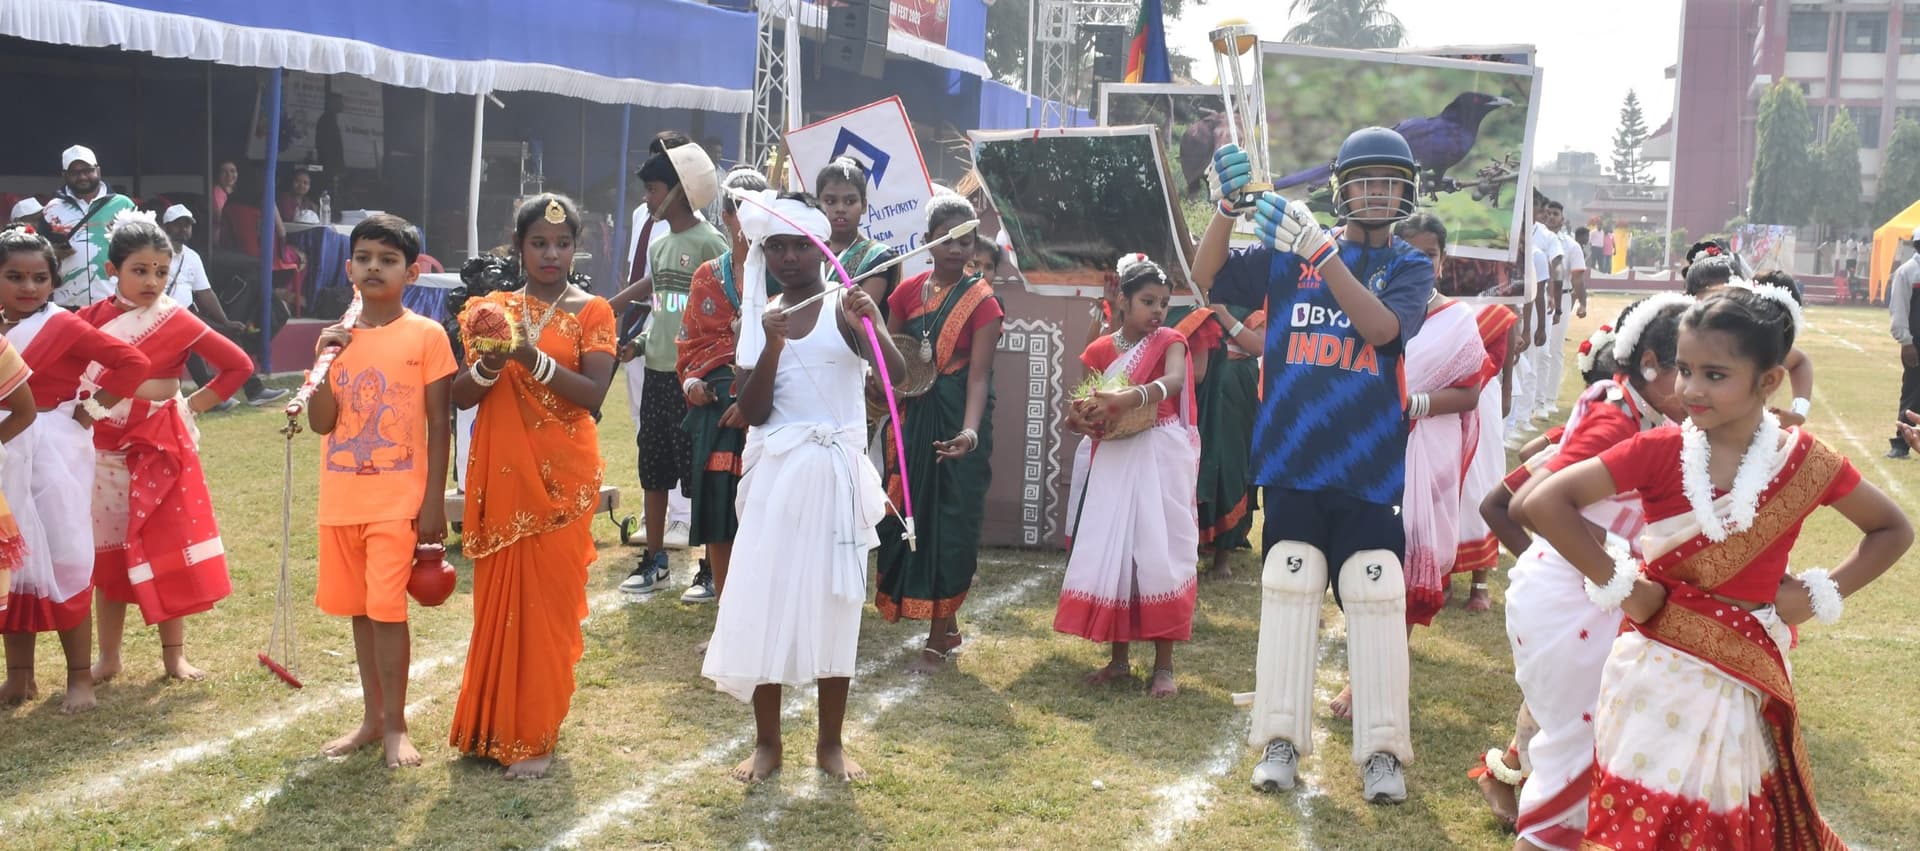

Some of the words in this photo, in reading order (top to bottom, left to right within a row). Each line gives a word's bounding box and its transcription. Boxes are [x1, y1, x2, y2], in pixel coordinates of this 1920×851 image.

[898, 4, 908, 20] FEST
[868, 200, 918, 222] AUTHORITY
[1285, 331, 1380, 376] INDIA
